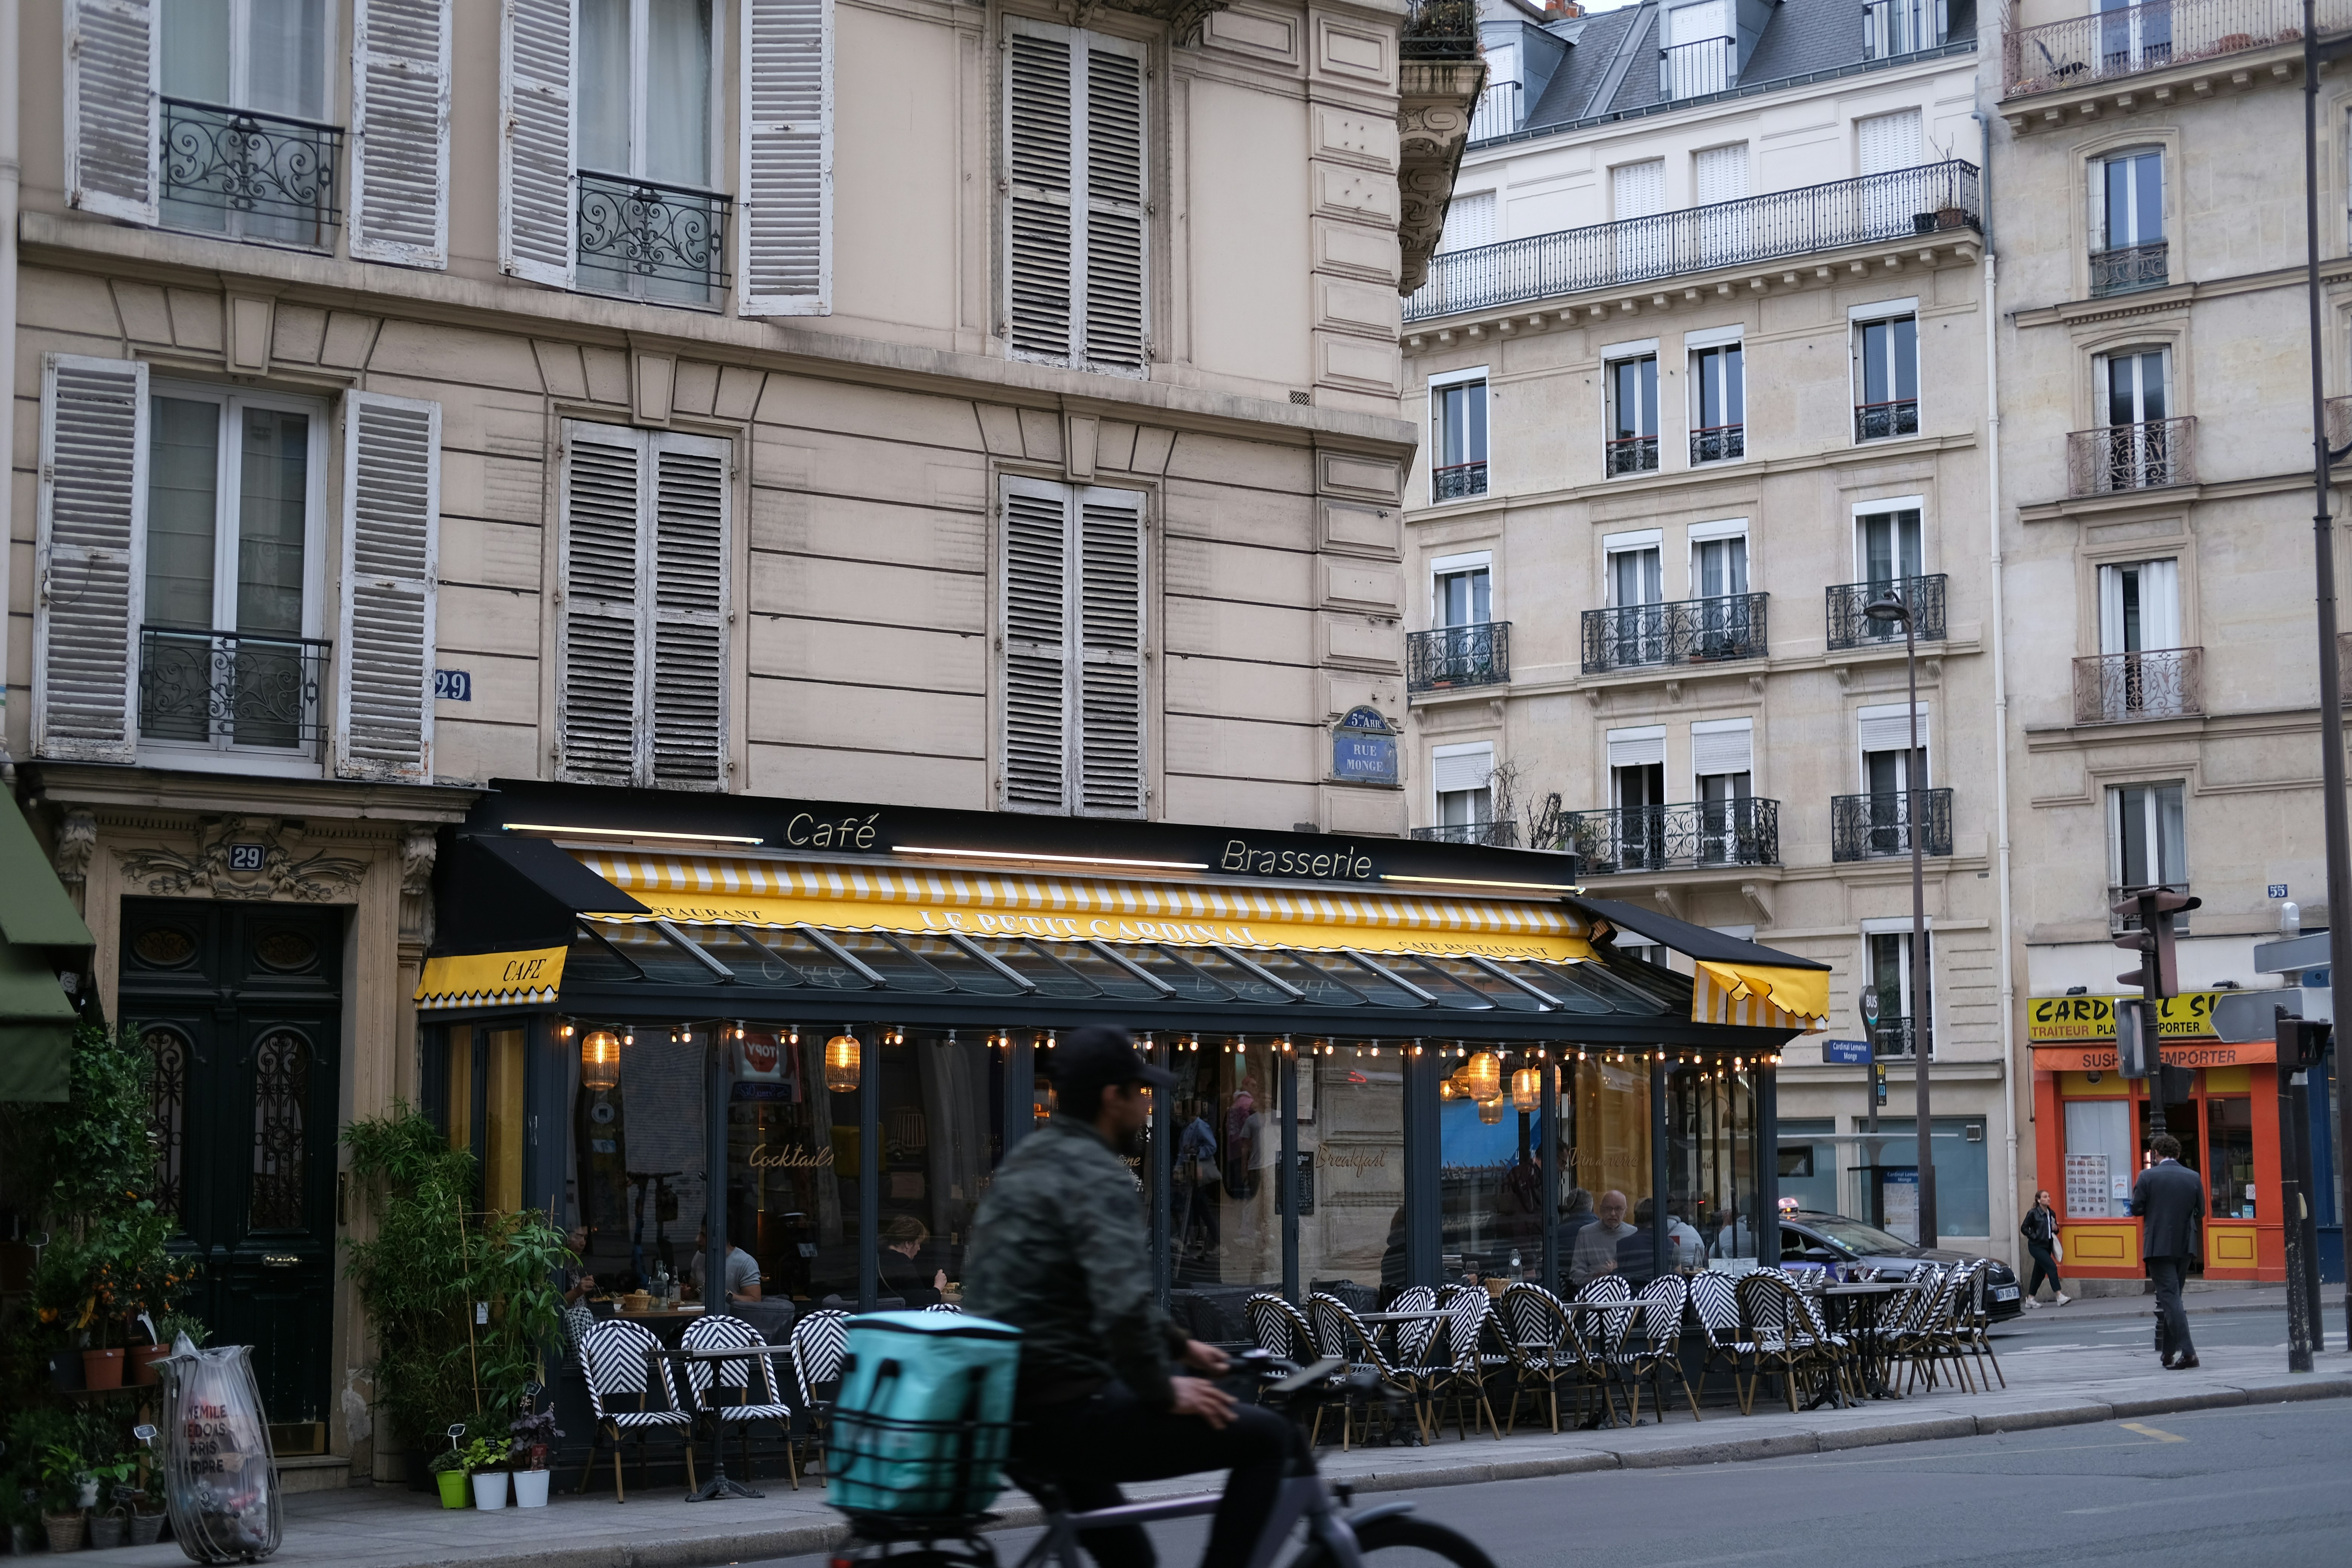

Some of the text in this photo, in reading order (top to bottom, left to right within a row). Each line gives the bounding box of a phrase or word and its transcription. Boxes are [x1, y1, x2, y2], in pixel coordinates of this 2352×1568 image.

[435, 672, 465, 699] 29
[1354, 744, 1377, 756] RUE
[1347, 759, 1383, 772] MONGE
[787, 813, 879, 849] Café
[234, 847, 259, 868] 29
[1221, 839, 1372, 879] Brasserie
[2270, 885, 2285, 897] 55
[651, 906, 761, 920] STAURANT
[917, 911, 1268, 943] LE PETIT CARDINAL
[1398, 941, 1549, 956] CAFE RESTAURANT
[503, 959, 547, 982] CAFE
[1866, 994, 1877, 1008] BUS
[2031, 1025, 2089, 1037] TRAITEUR
[2159, 1022, 2200, 1033] PORTER
[1833, 1042, 1867, 1052] Cardinal Lemoine
[1844, 1052, 1857, 1062] Monge
[2082, 1054, 2118, 1067] SUSH
[1878, 1065, 1884, 1074] 75
[749, 1143, 834, 1167] Cocktails
[1315, 1144, 1389, 1178] Breakfast
[1568, 1147, 1594, 1167] Vin
[1609, 1155, 1638, 1167] verre
